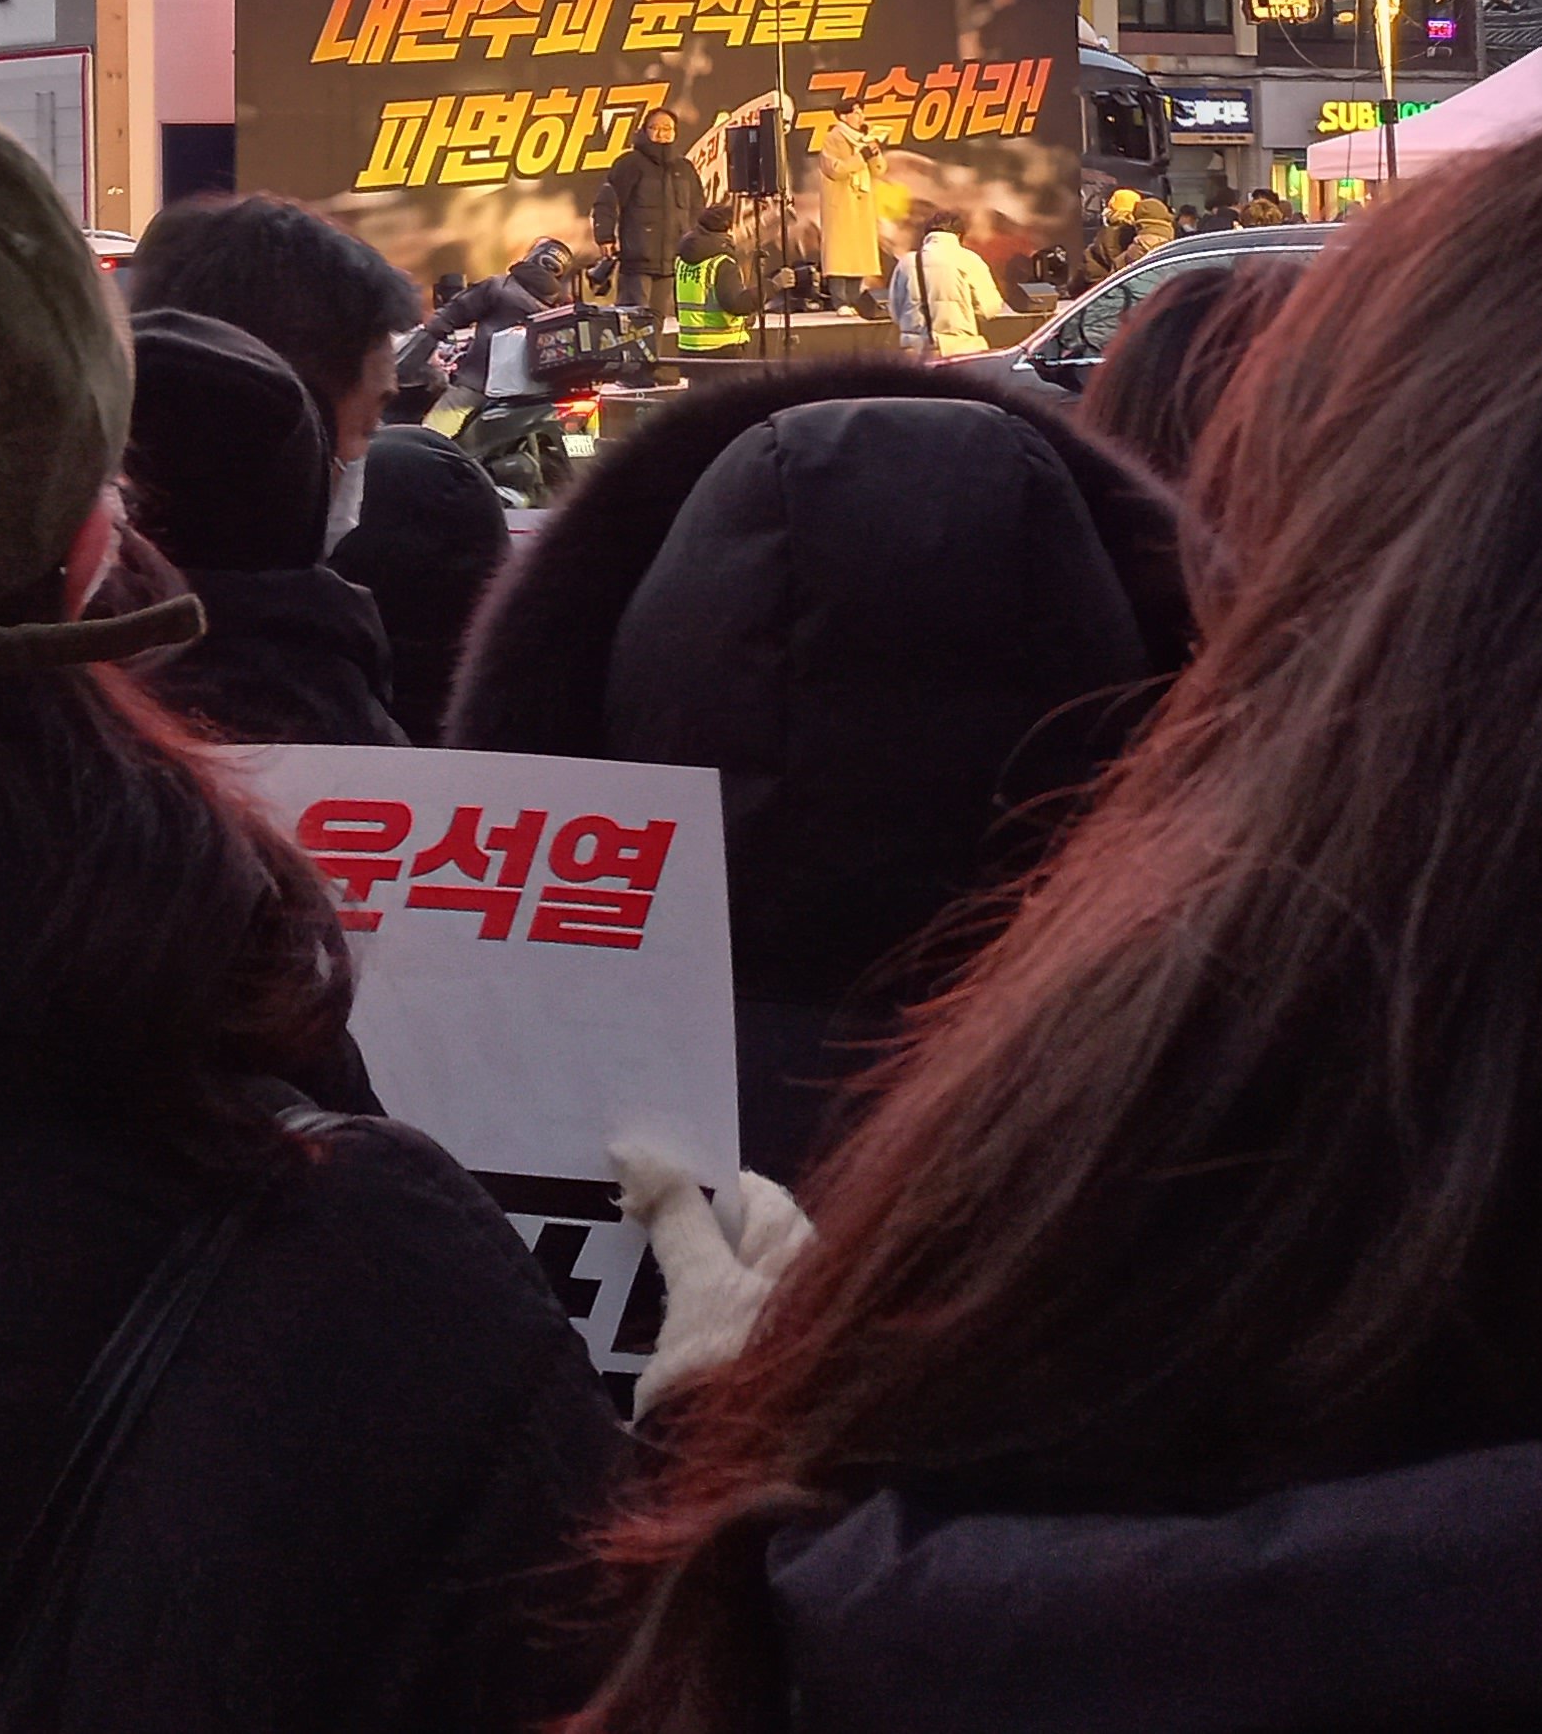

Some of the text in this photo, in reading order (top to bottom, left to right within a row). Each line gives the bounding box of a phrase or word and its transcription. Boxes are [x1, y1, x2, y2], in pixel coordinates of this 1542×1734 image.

[353, 56, 1053, 190] 파면하고 구속하라!
[1317, 101, 1443, 133] SUBA
[297, 798, 678, 950] 윤석열
